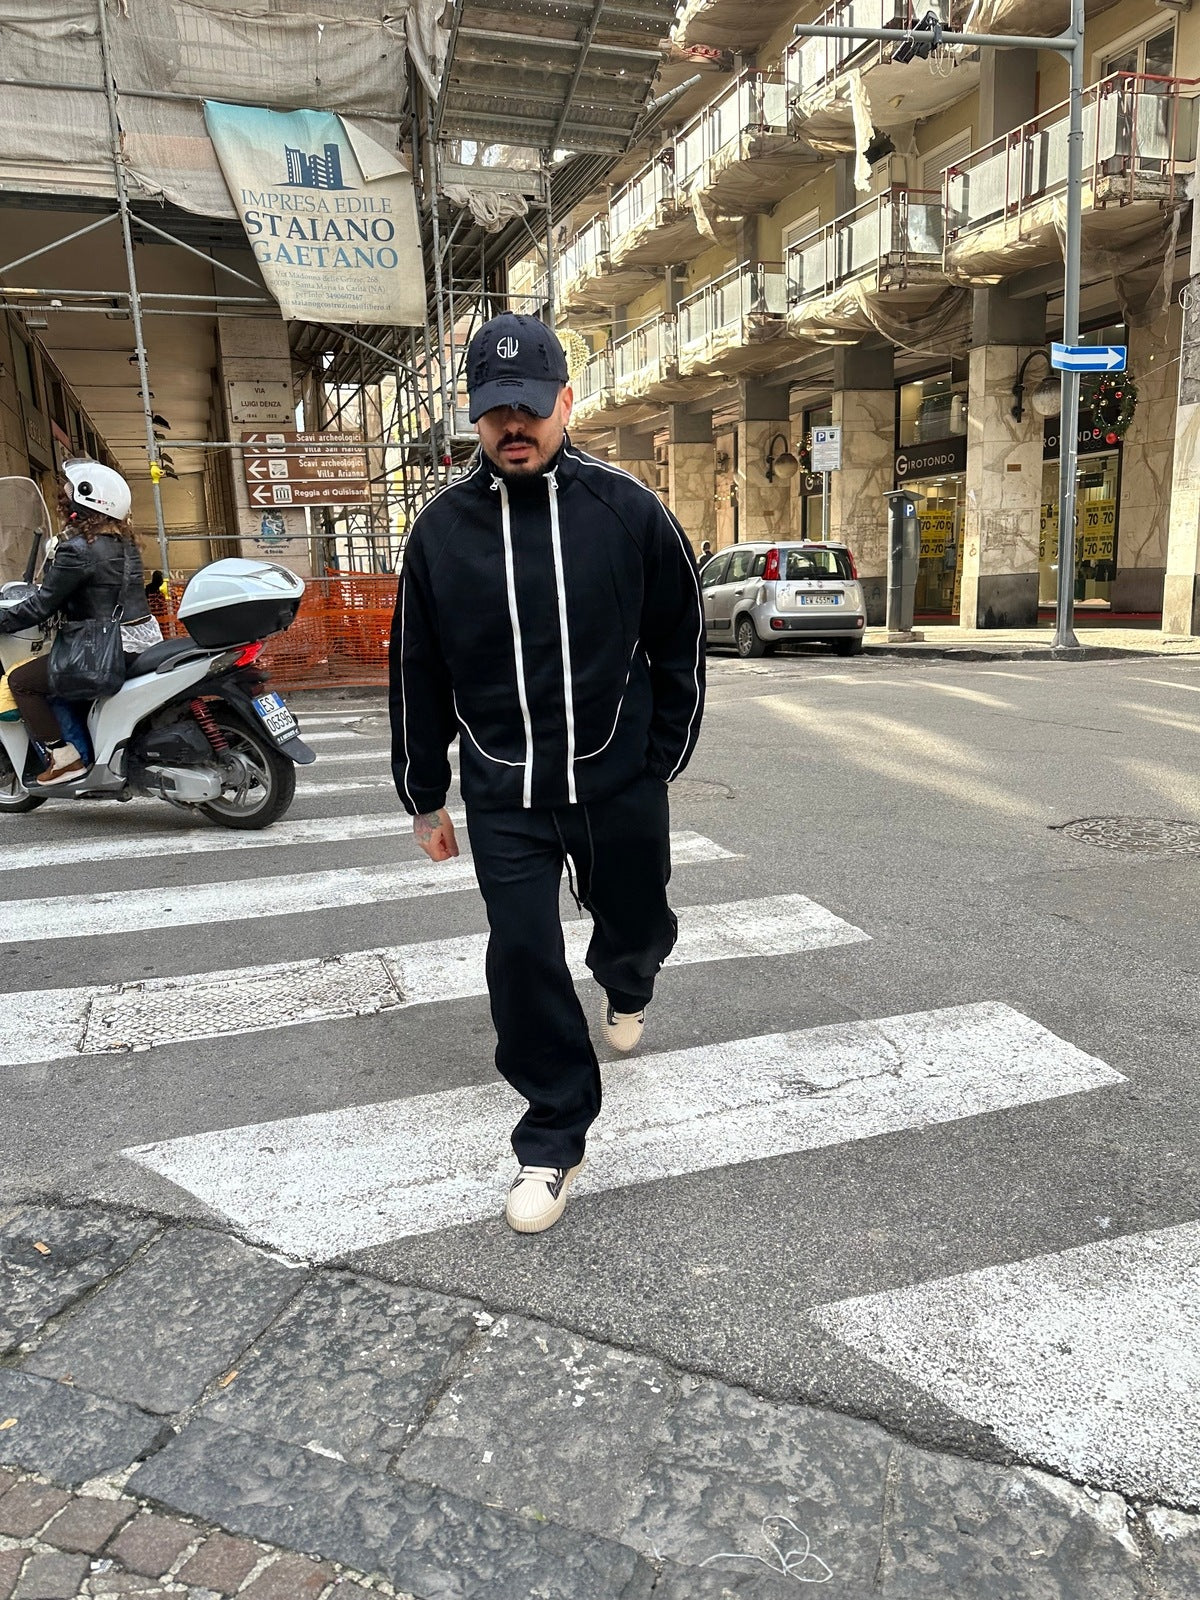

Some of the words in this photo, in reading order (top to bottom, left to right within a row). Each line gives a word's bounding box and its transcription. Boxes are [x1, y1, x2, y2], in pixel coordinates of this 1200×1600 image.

[241, 188, 330, 214] IMPRESA
[335, 197, 393, 214] EDILE
[244, 210, 395, 242] STAIANO
[251, 240, 399, 269] GAETANO
[296, 433, 315, 442] Scavi
[318, 433, 361, 443] archeologici
[298, 458, 318, 467] Scavi
[321, 458, 364, 468] archeologici
[895, 453, 956, 476] GIROTONDO
[316, 469, 335, 478] Villa
[338, 469, 365, 478] Arianna
[294, 489, 321, 498] Reggia
[322, 488, 330, 496] di
[332, 488, 369, 496] Quisisana
[1084, 542, 1098, 555] -70
[1099, 541, 1113, 555] -70
[259, 697, 275, 713] ES
[266, 711, 293, 733] 06396
